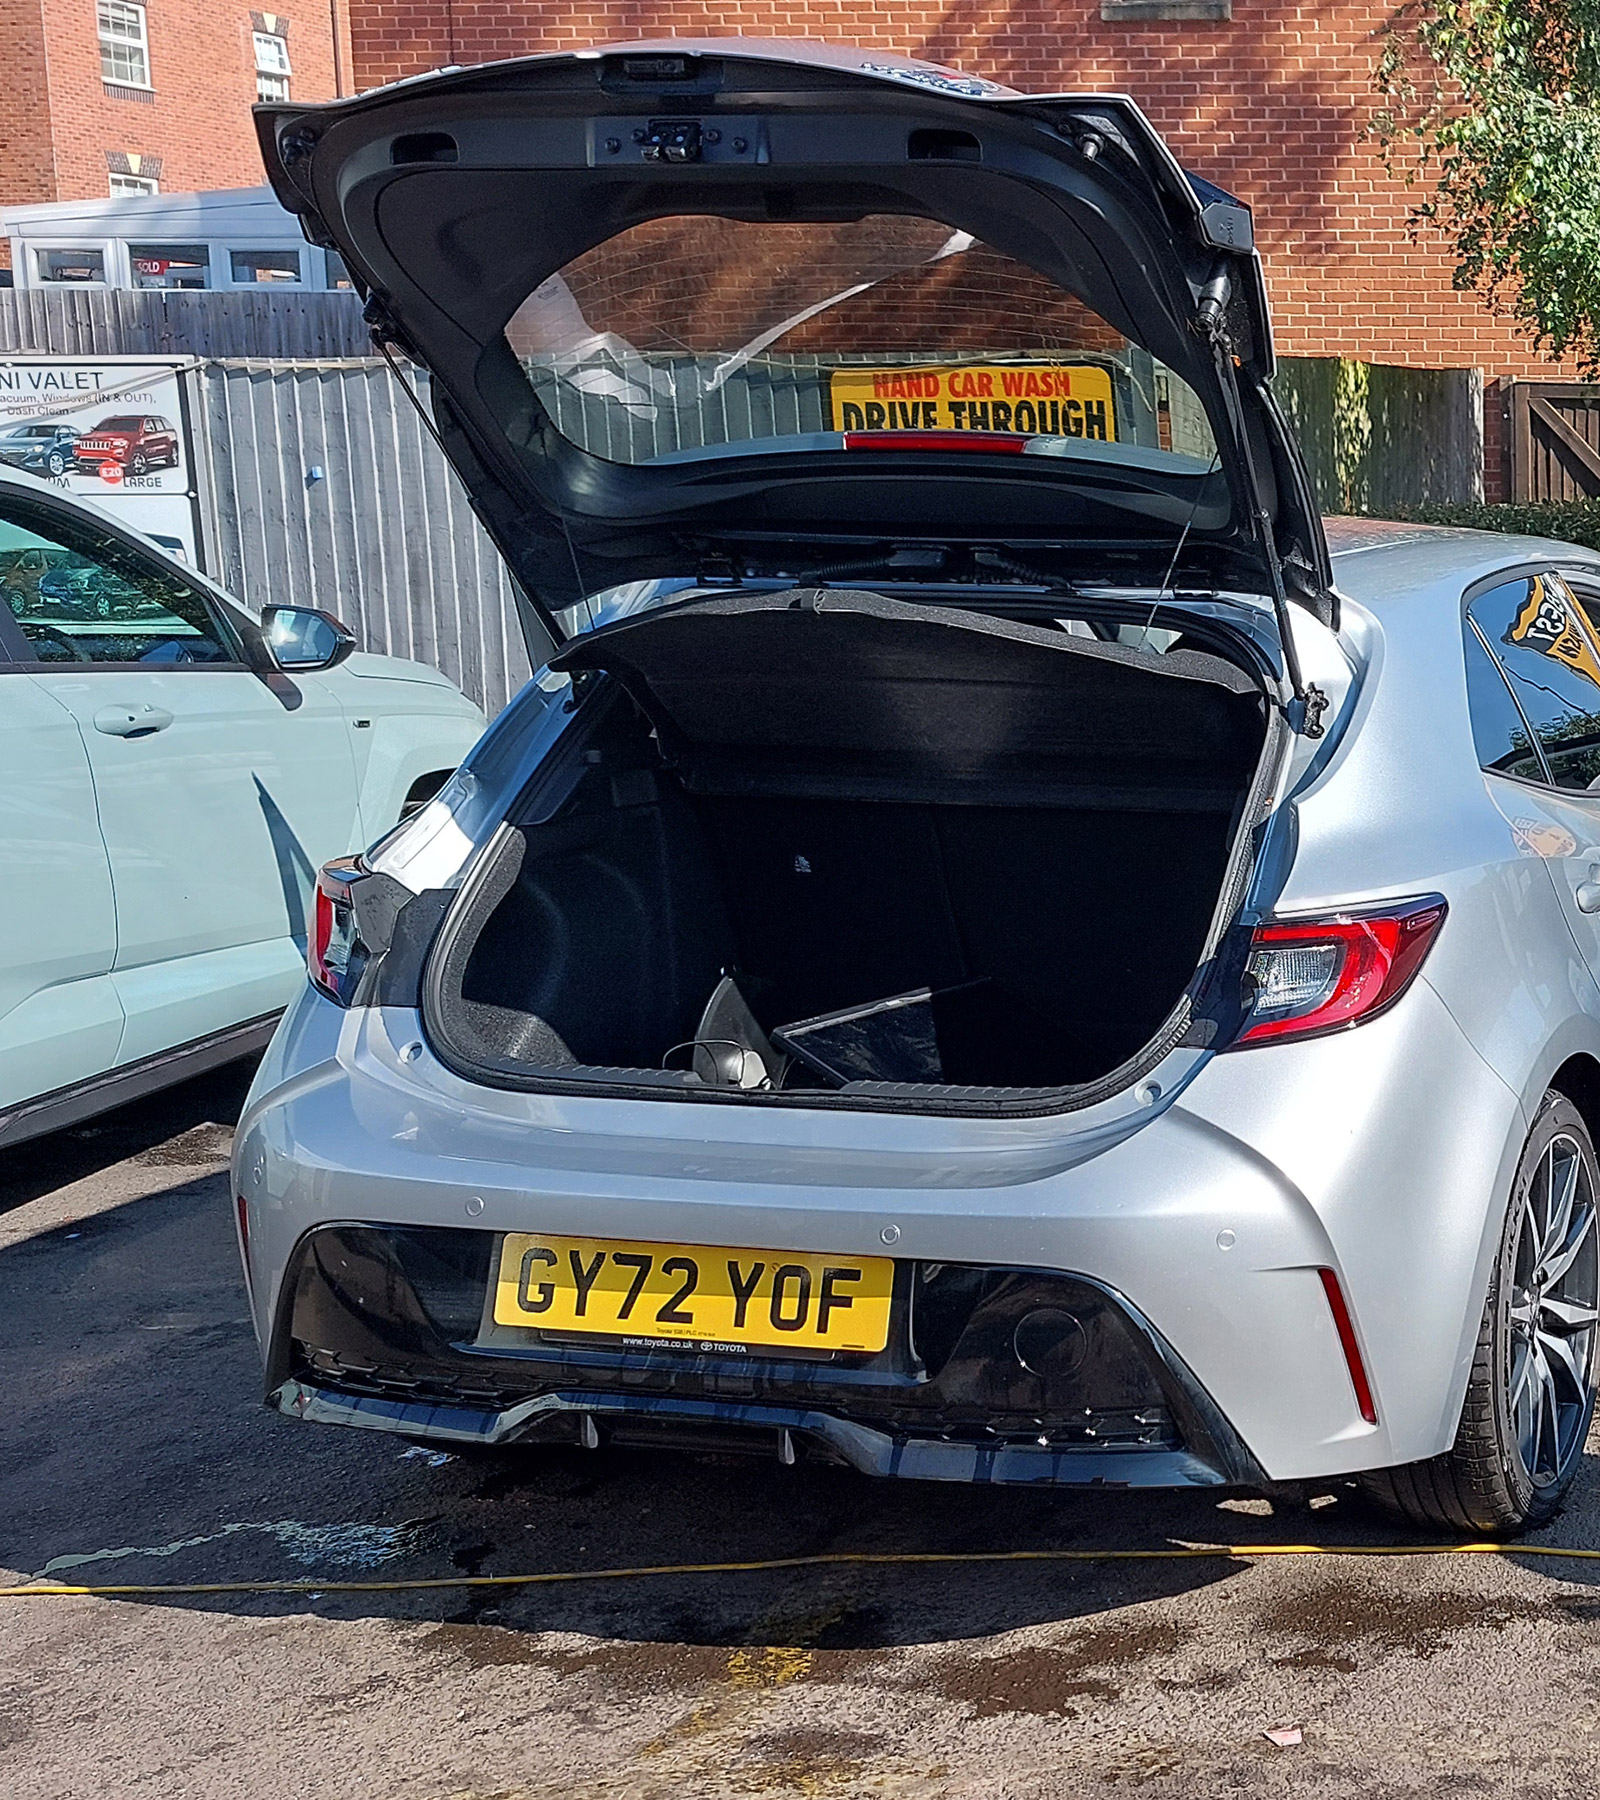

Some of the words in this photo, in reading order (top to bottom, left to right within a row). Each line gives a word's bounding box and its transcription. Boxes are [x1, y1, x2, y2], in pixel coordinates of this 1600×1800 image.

[138, 261, 160, 273] SOLD
[27, 371, 104, 390] VALET
[873, 372, 940, 398] HAND
[949, 371, 994, 398] CAR
[1000, 371, 1071, 398] WASH
[113, 394, 121, 402] &
[841, 401, 938, 430] DRIVE
[949, 399, 1106, 441] THROUGH
[123, 477, 162, 488] LARGE
[517, 1246, 700, 1325] GY72
[727, 1259, 862, 1334] YOF
[622, 1337, 694, 1350] www.toyota.co.uk
[713, 1343, 747, 1353] TOYOTA
